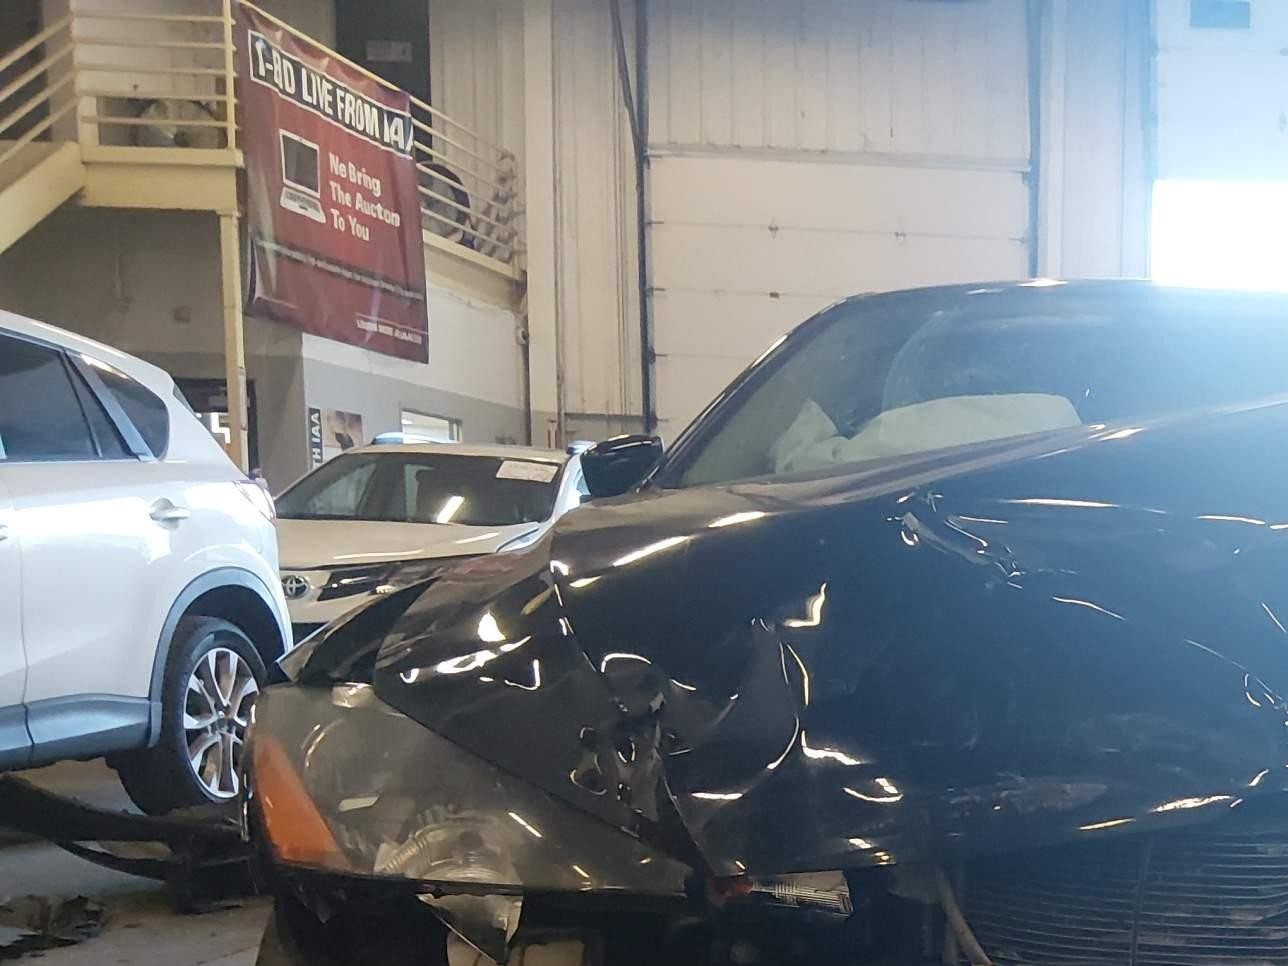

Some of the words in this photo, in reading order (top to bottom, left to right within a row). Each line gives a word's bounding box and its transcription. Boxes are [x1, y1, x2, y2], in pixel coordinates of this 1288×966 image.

[301, 67, 334, 116] LIVE
[336, 89, 380, 139] FROM
[329, 180, 352, 208] The
[348, 161, 381, 198] Bring
[330, 208, 346, 232] To
[348, 214, 370, 242] You
[311, 412, 321, 443] IAA
